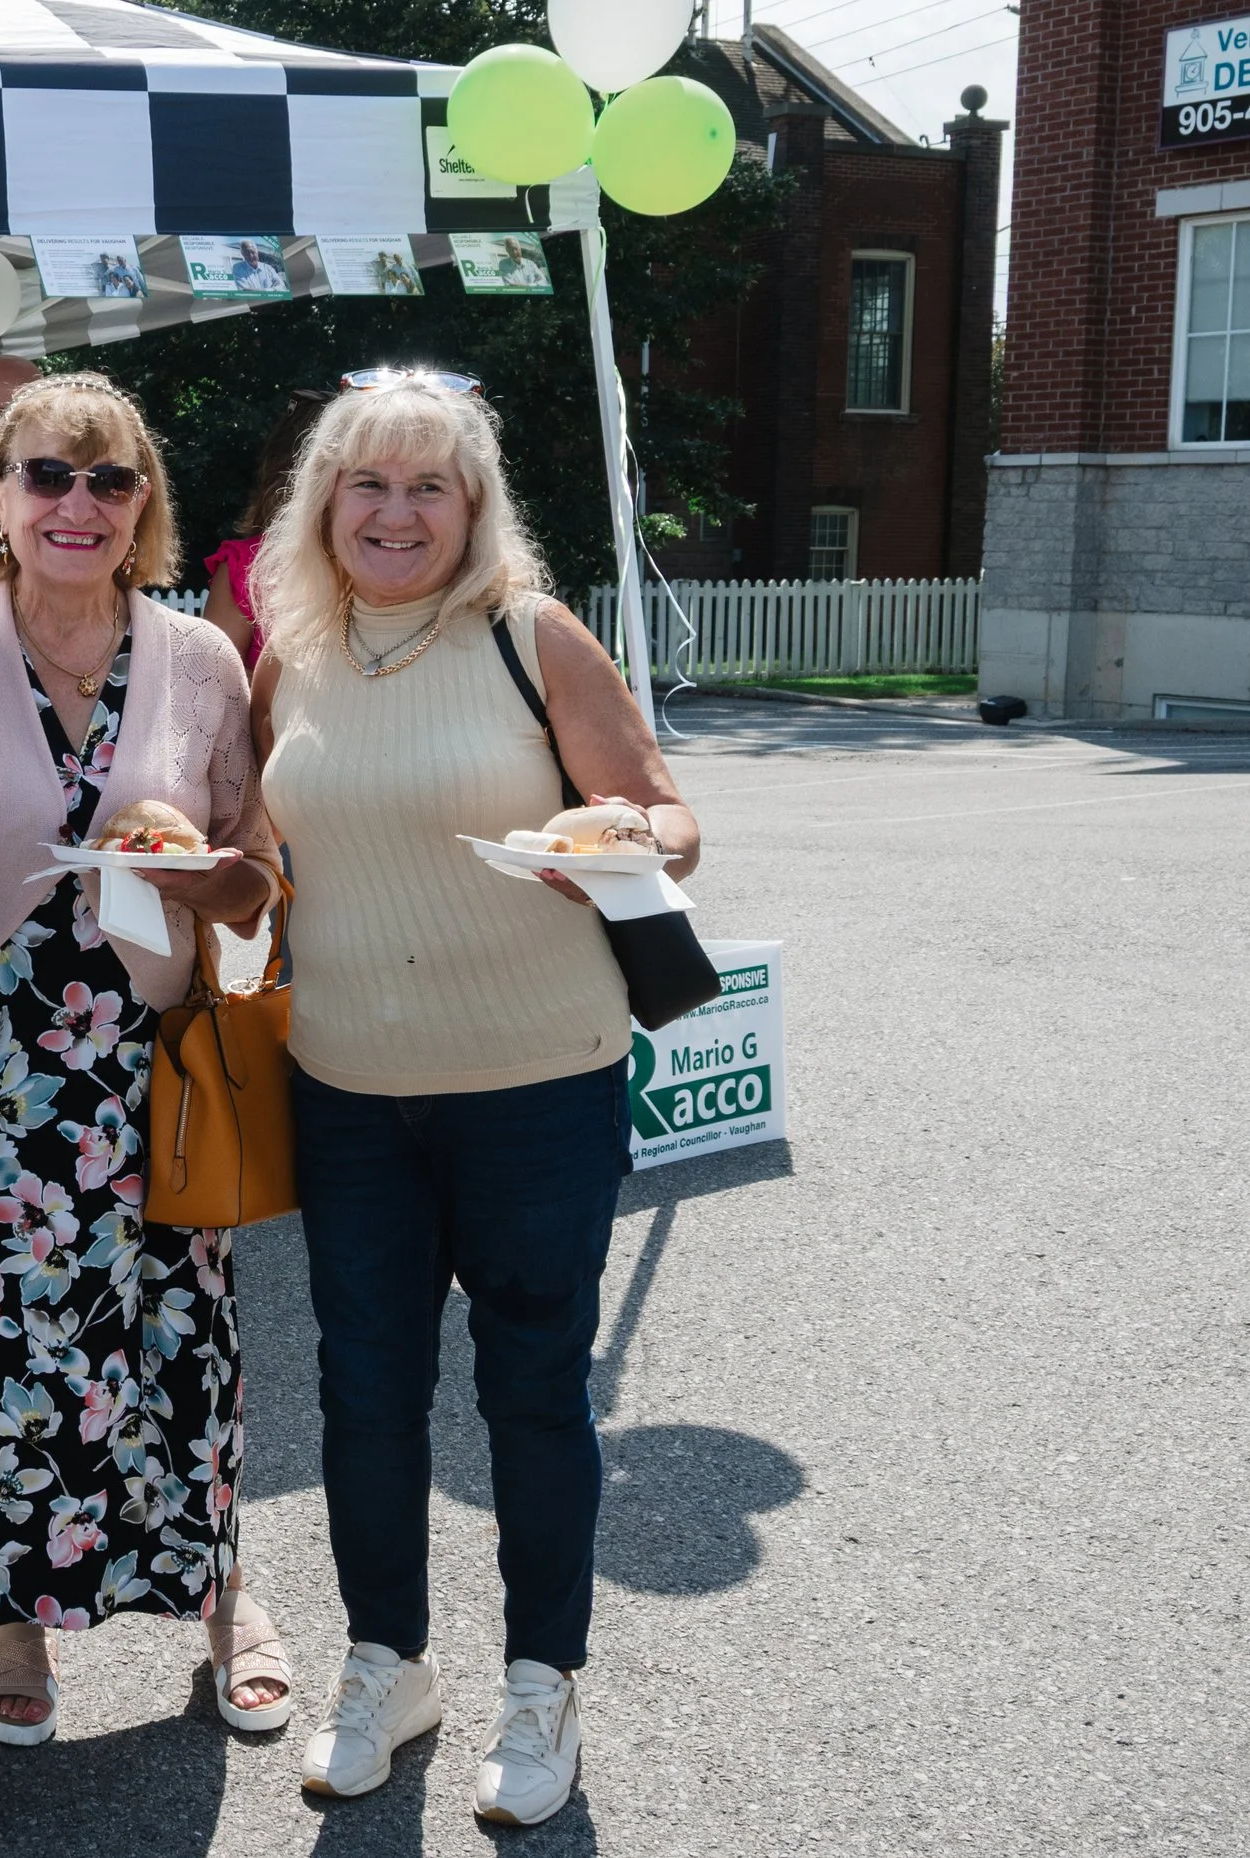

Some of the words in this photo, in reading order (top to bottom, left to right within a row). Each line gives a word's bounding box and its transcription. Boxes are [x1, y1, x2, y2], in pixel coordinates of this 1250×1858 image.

[1217, 28, 1250, 52] Ve
[719, 968, 767, 993] SPONSIVE
[670, 1039, 735, 1077] Mario
[741, 1031, 759, 1060] G
[641, 1140, 678, 1159] Regional
[679, 1131, 723, 1149] Councillor
[729, 1120, 767, 1136] Vaughan
